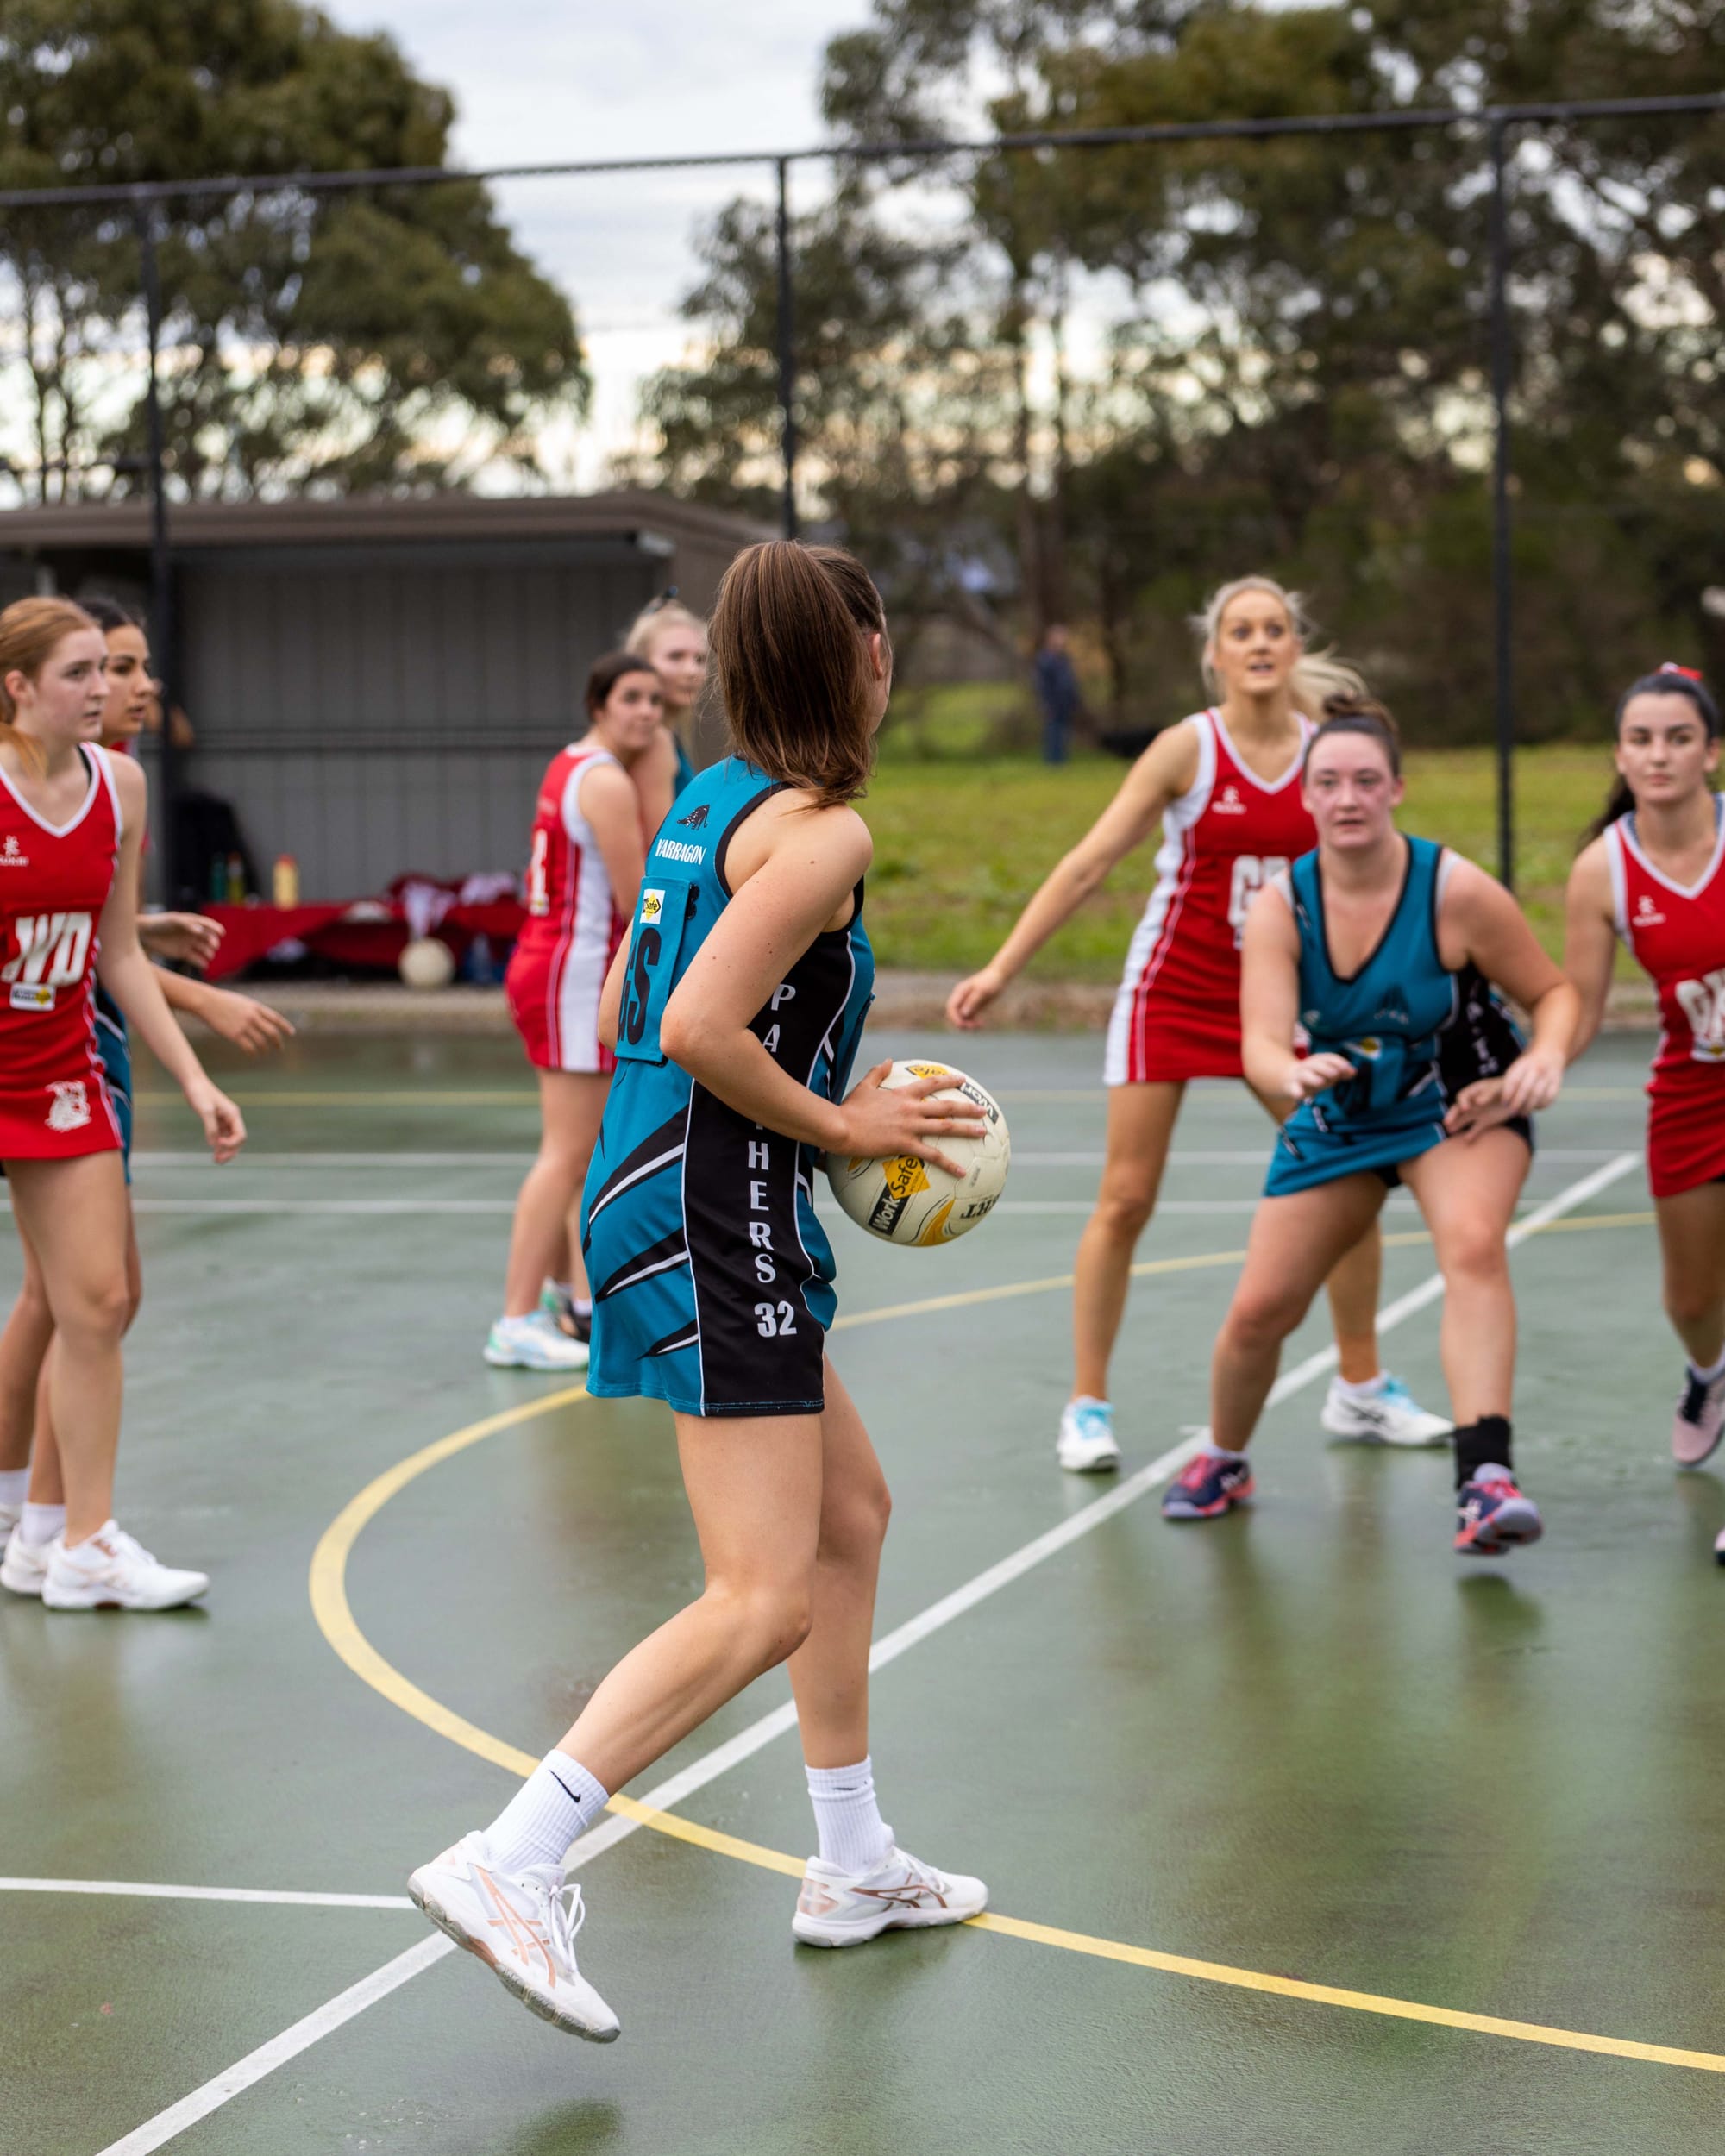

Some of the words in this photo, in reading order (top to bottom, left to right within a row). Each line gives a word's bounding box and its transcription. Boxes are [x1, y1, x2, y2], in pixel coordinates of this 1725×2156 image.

[656, 838, 707, 865] YARRAGON
[748, 984, 796, 1283] PAHERS
[754, 1300, 797, 1338] 32
